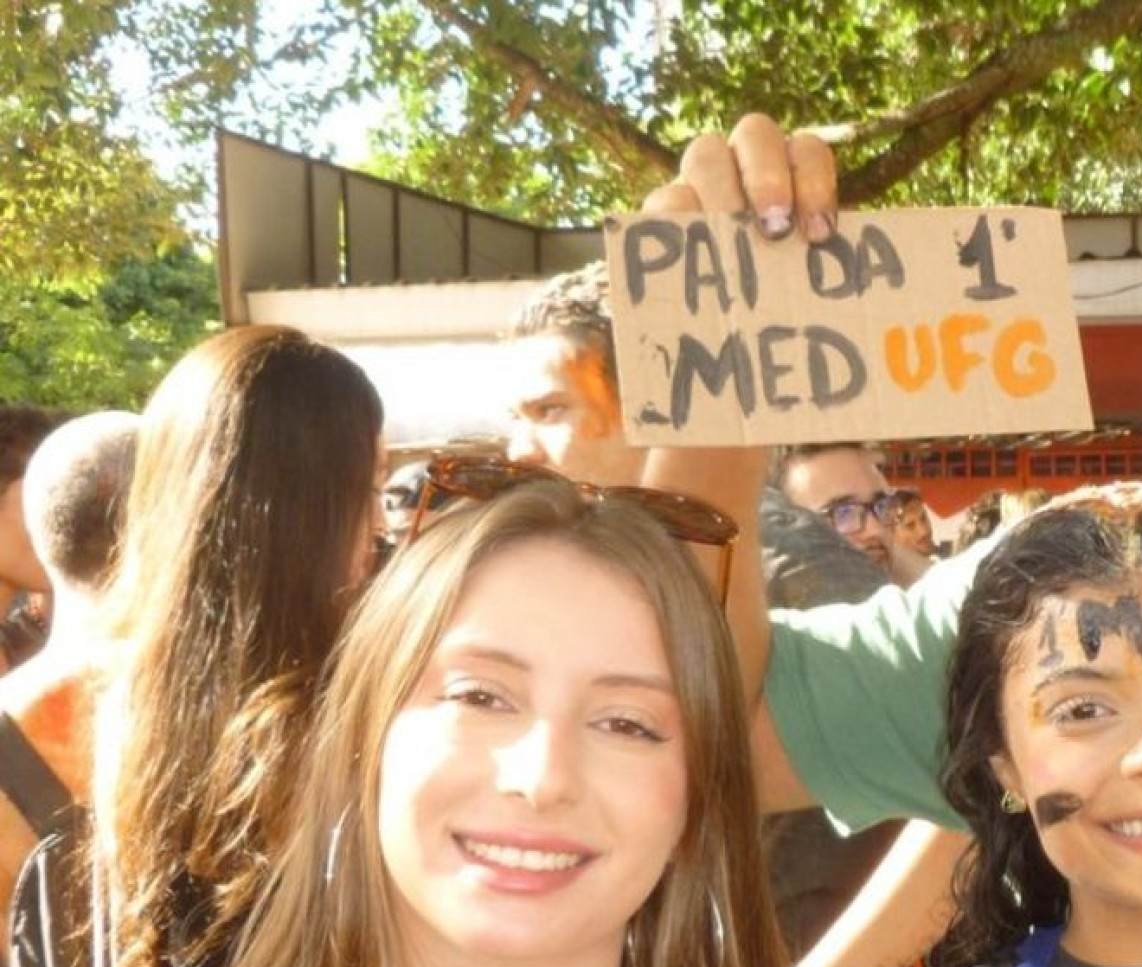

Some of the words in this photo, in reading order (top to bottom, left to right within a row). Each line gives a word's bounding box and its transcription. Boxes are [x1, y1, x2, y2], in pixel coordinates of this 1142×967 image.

[624, 219, 759, 314] PAI
[806, 224, 905, 298] DA
[669, 325, 868, 430] MED
[884, 313, 1056, 398] UFG
